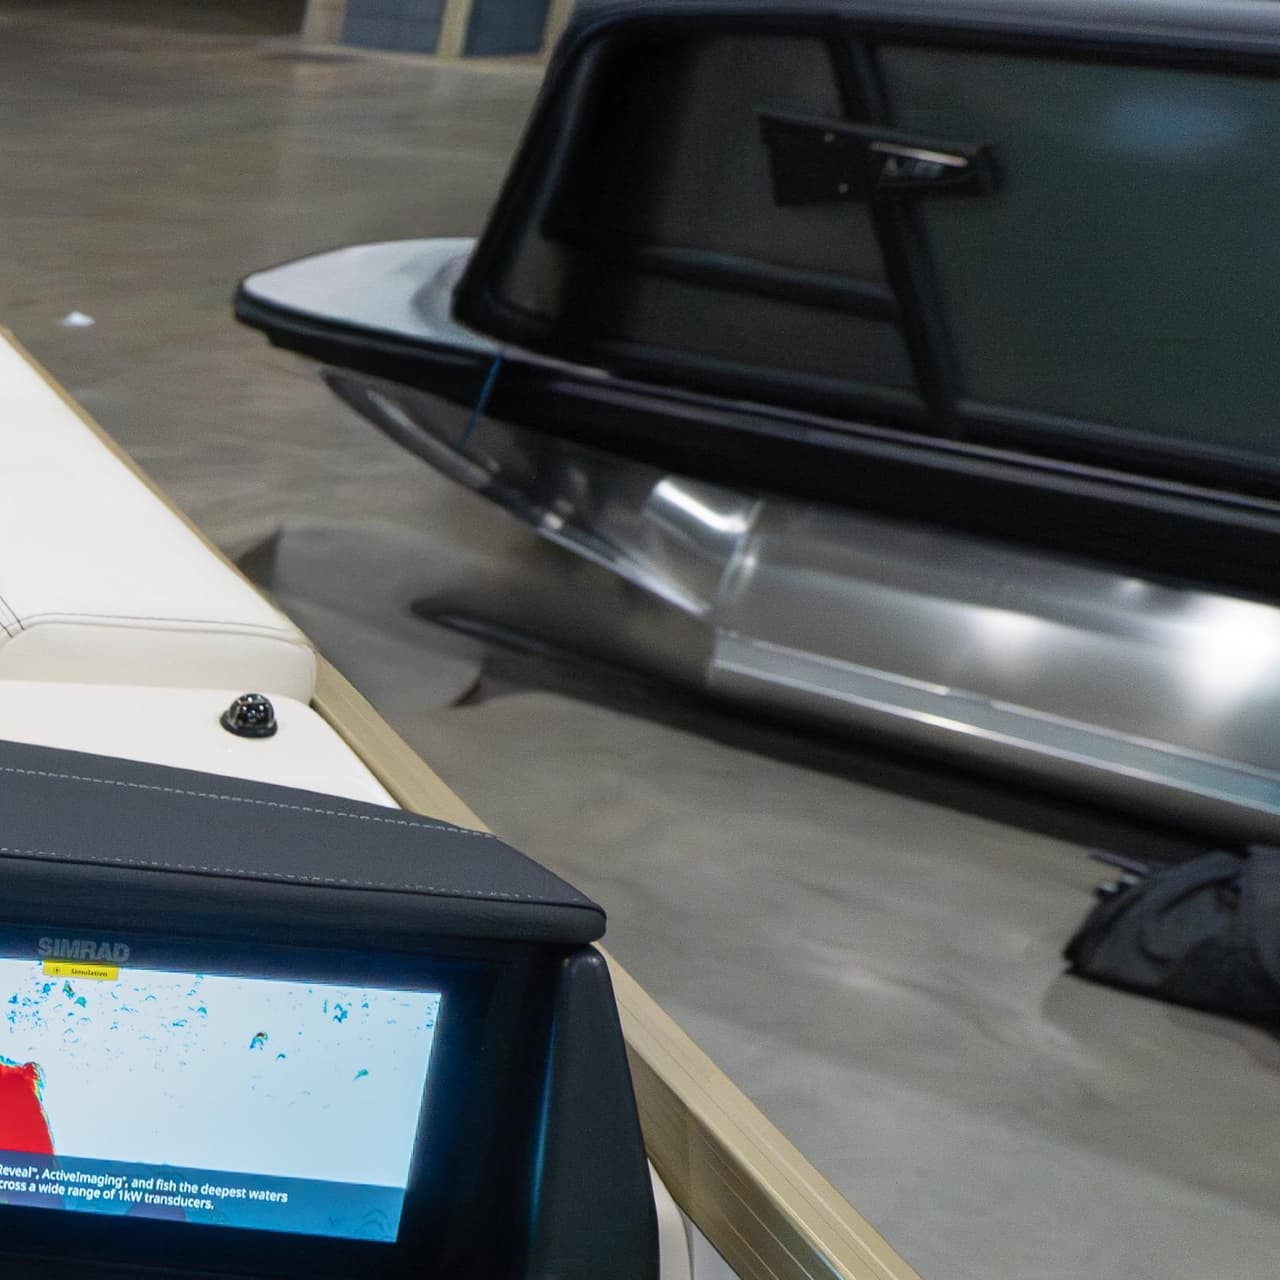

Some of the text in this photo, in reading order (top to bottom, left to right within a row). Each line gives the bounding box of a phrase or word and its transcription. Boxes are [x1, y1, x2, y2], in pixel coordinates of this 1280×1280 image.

[38, 937, 130, 962] SIMRAD
[71, 968, 108, 977] Simulation
[28, 1184, 37, 1193] a
[39, 1183, 66, 1196] wide
[67, 1187, 101, 1200] range
[102, 1188, 116, 1200] of
[118, 1190, 142, 1203] 1kW
[144, 1194, 214, 1210] transducers.
[131, 1177, 154, 1191] and
[156, 1178, 177, 1193] fish
[179, 1181, 199, 1195] the
[200, 1183, 247, 1200] deepest
[249, 1190, 289, 1203] waters
